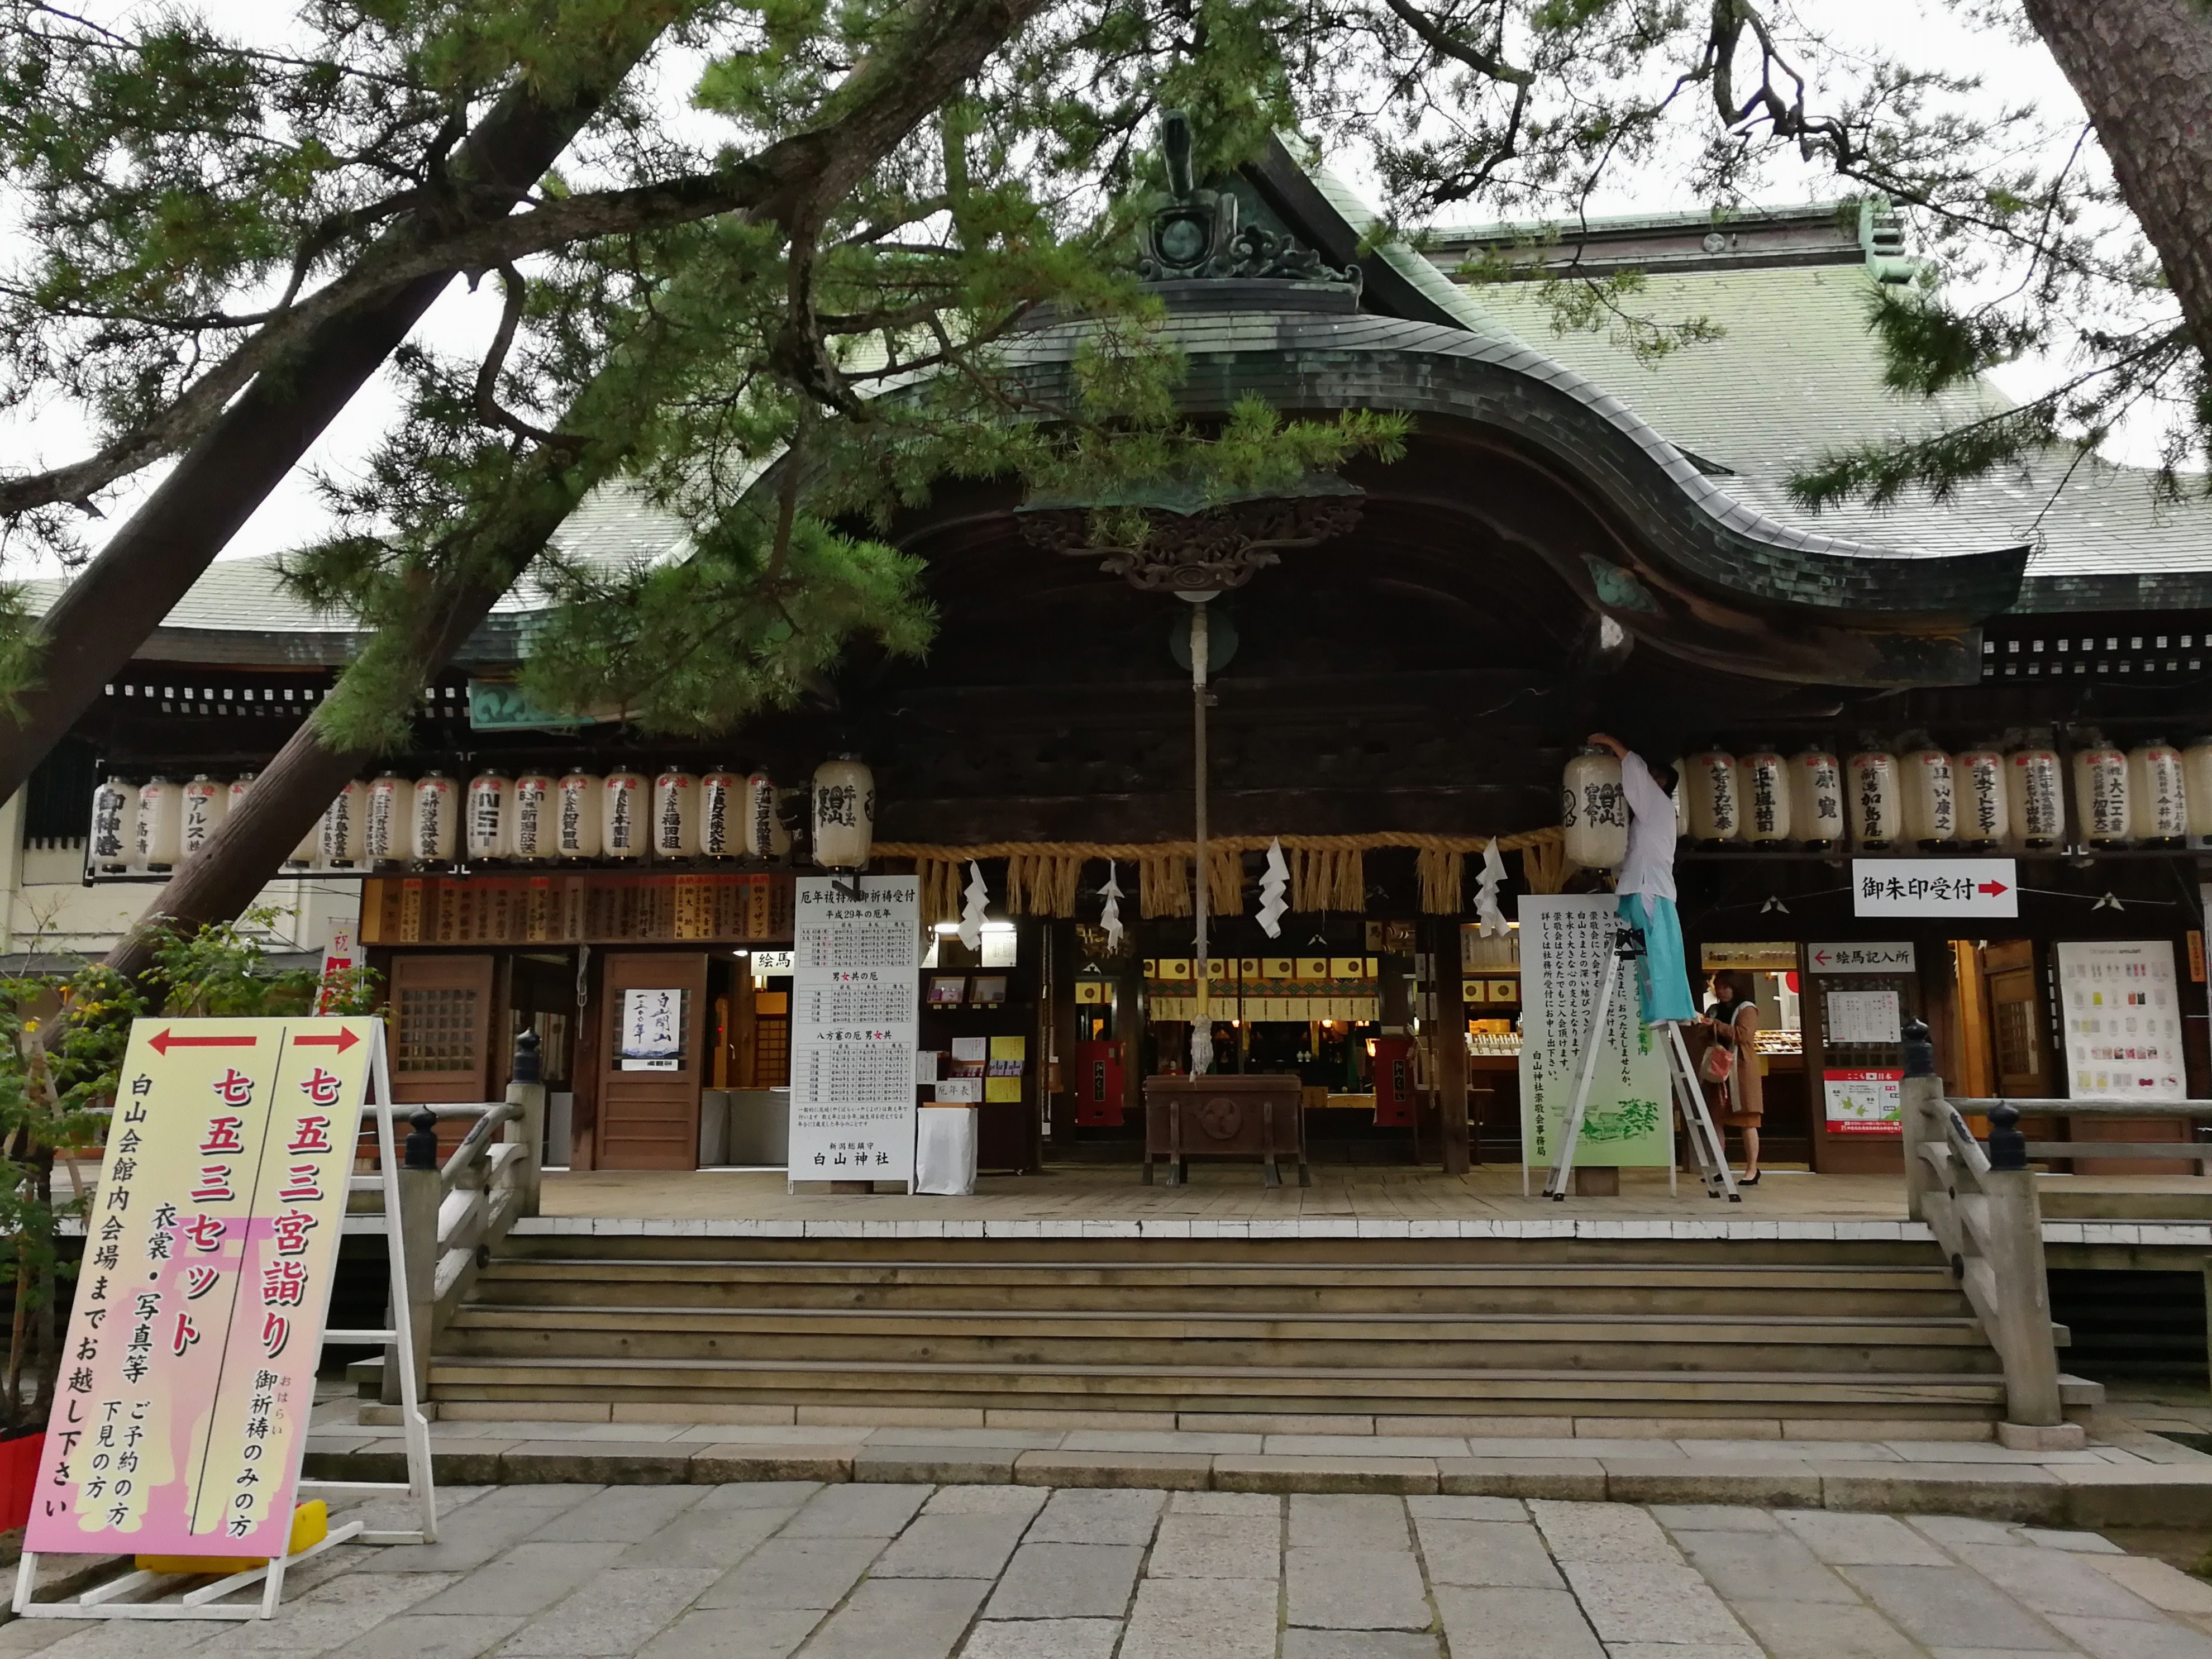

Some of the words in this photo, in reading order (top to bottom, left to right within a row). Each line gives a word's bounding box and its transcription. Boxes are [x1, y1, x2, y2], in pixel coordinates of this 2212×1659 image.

[825, 909, 892, 920] 平成29年の厄年
[1861, 876, 1976, 902] 御朱印受付
[833, 972, 879, 981] 男女共の厄
[1541, 912, 1558, 1081] 詳しくは社務所受付にお申し出下さい。
[1553, 912, 1569, 1071] 崇敬会はどなたでもご入会頂けます。
[1836, 950, 1910, 965] 絵馬記入所
[865, 1030, 892, 1040] 男女共
[937, 1085, 970, 1097] 厄年表
[1533, 1050, 1546, 1156] 白山神社崇敬会事務局
[814, 1151, 889, 1166] 白山神社
[173, 1068, 254, 1356] 七五三セット
[263, 1067, 341, 1358] 七五三宮詣り
[46, 1073, 153, 1517] 白山会館内会場までお越し下さい
[122, 1202, 178, 1384] 衣裳・写真等
[85, 1401, 122, 1499] 下見の方
[227, 1369, 279, 1537] 御祈祷のみの方
[272, 1376, 291, 1434] おはらい
[107, 1401, 151, 1526] ご予約の方
